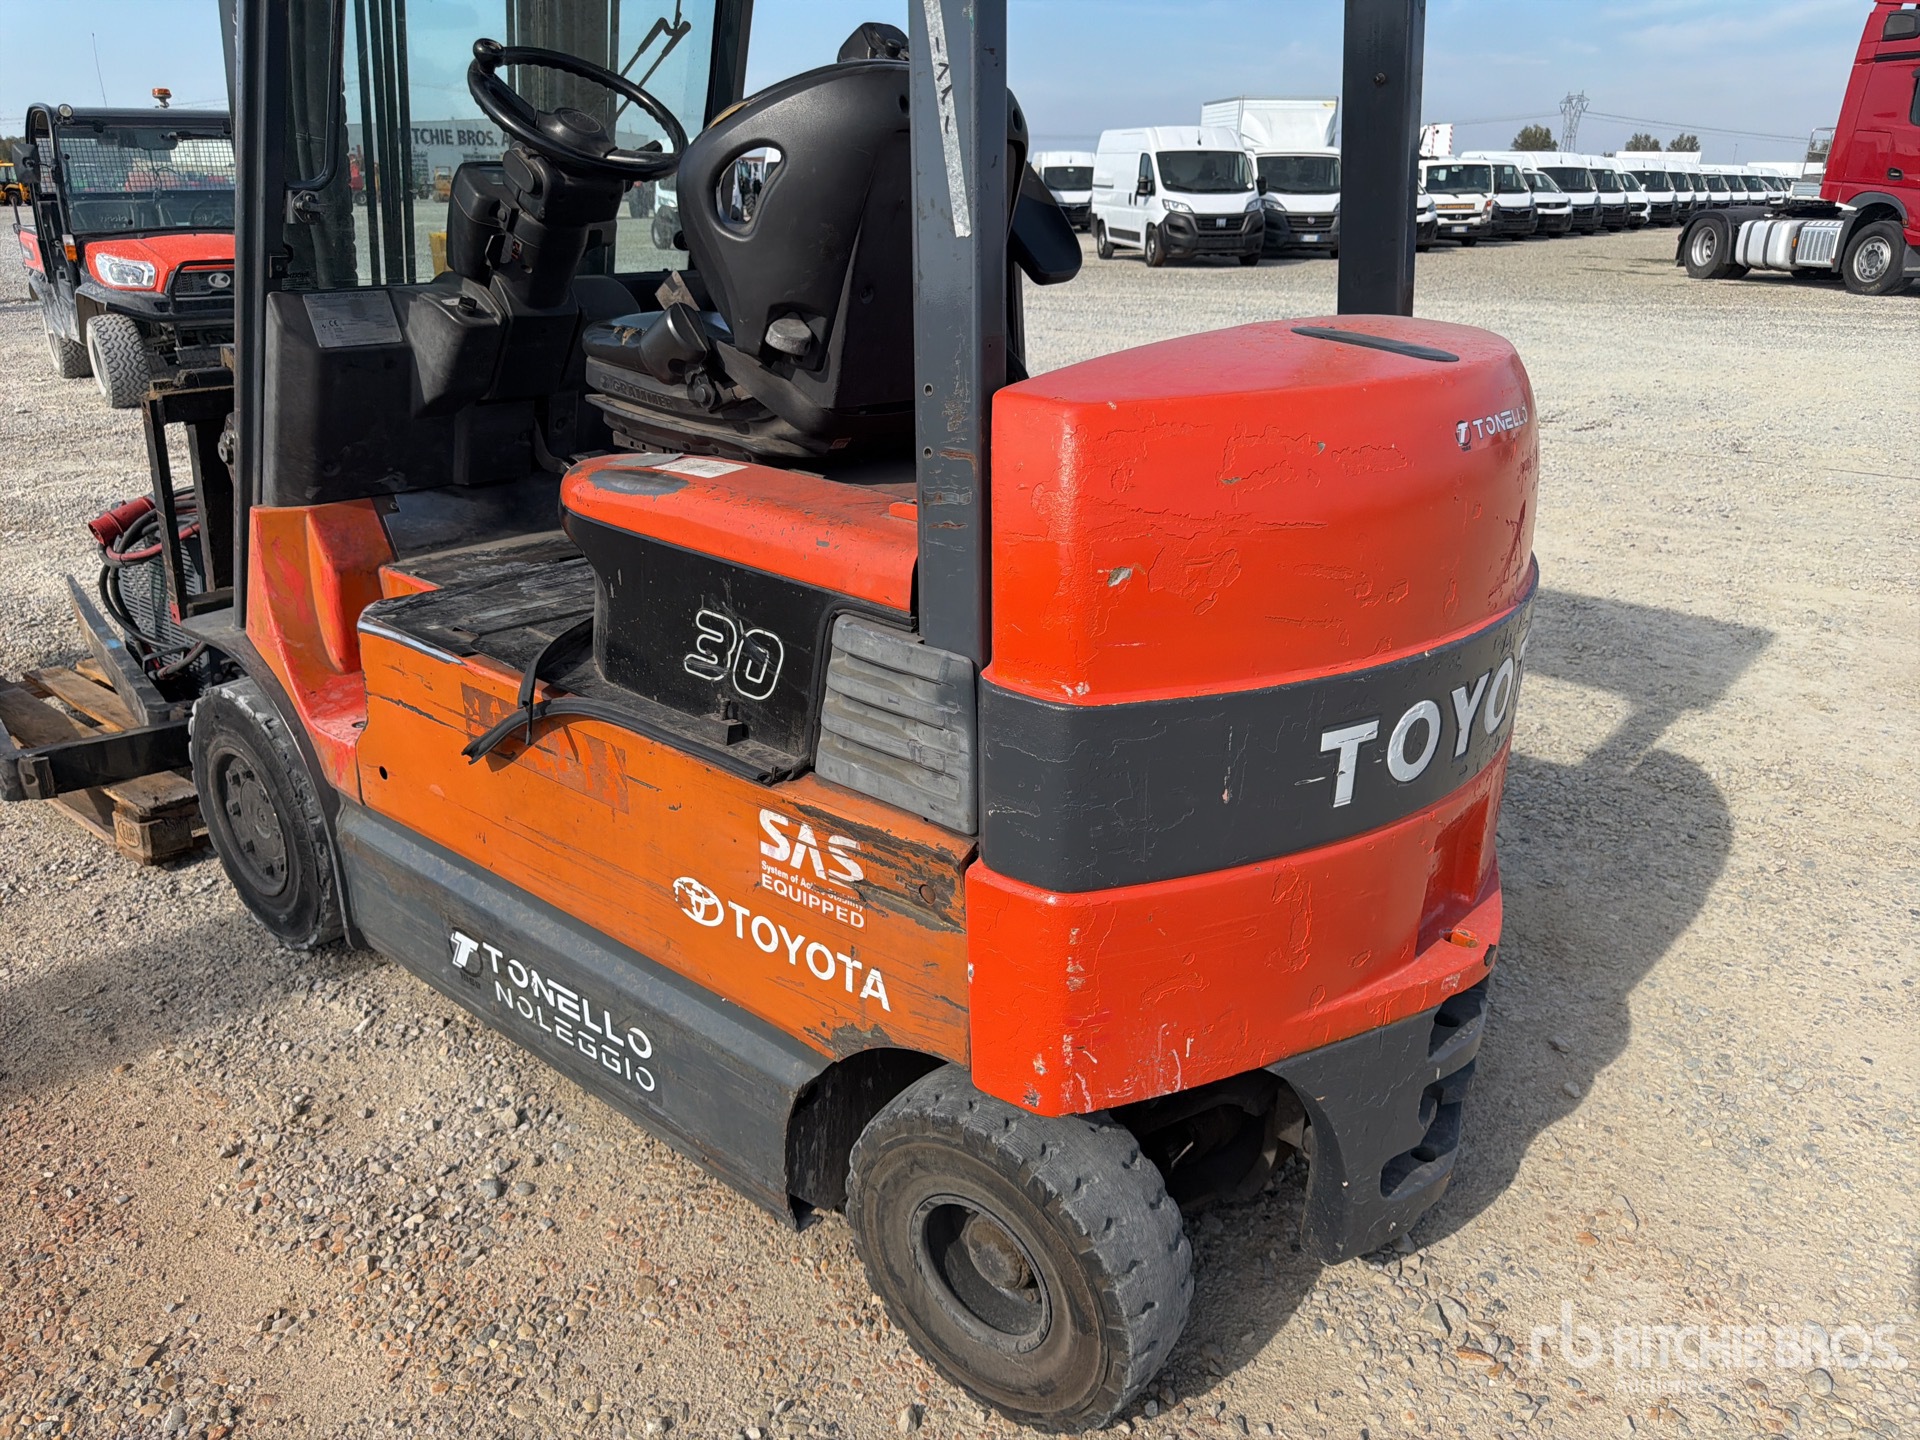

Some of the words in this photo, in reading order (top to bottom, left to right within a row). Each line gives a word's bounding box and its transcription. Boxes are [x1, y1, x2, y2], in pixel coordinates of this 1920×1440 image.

[398, 127, 454, 145] TCHIE
[457, 129, 498, 146] BROS.
[612, 379, 676, 410] GRAMMER
[1472, 405, 1528, 439] TONELLO
[684, 609, 784, 700] 30
[758, 808, 866, 884] SAS
[760, 860, 789, 880] System
[790, 874, 799, 884] of
[760, 873, 866, 930] EQUIPPED
[727, 900, 892, 1013] TOYOTA
[482, 941, 654, 1060] TONELLO
[494, 980, 656, 1093] NOLEGGIO
